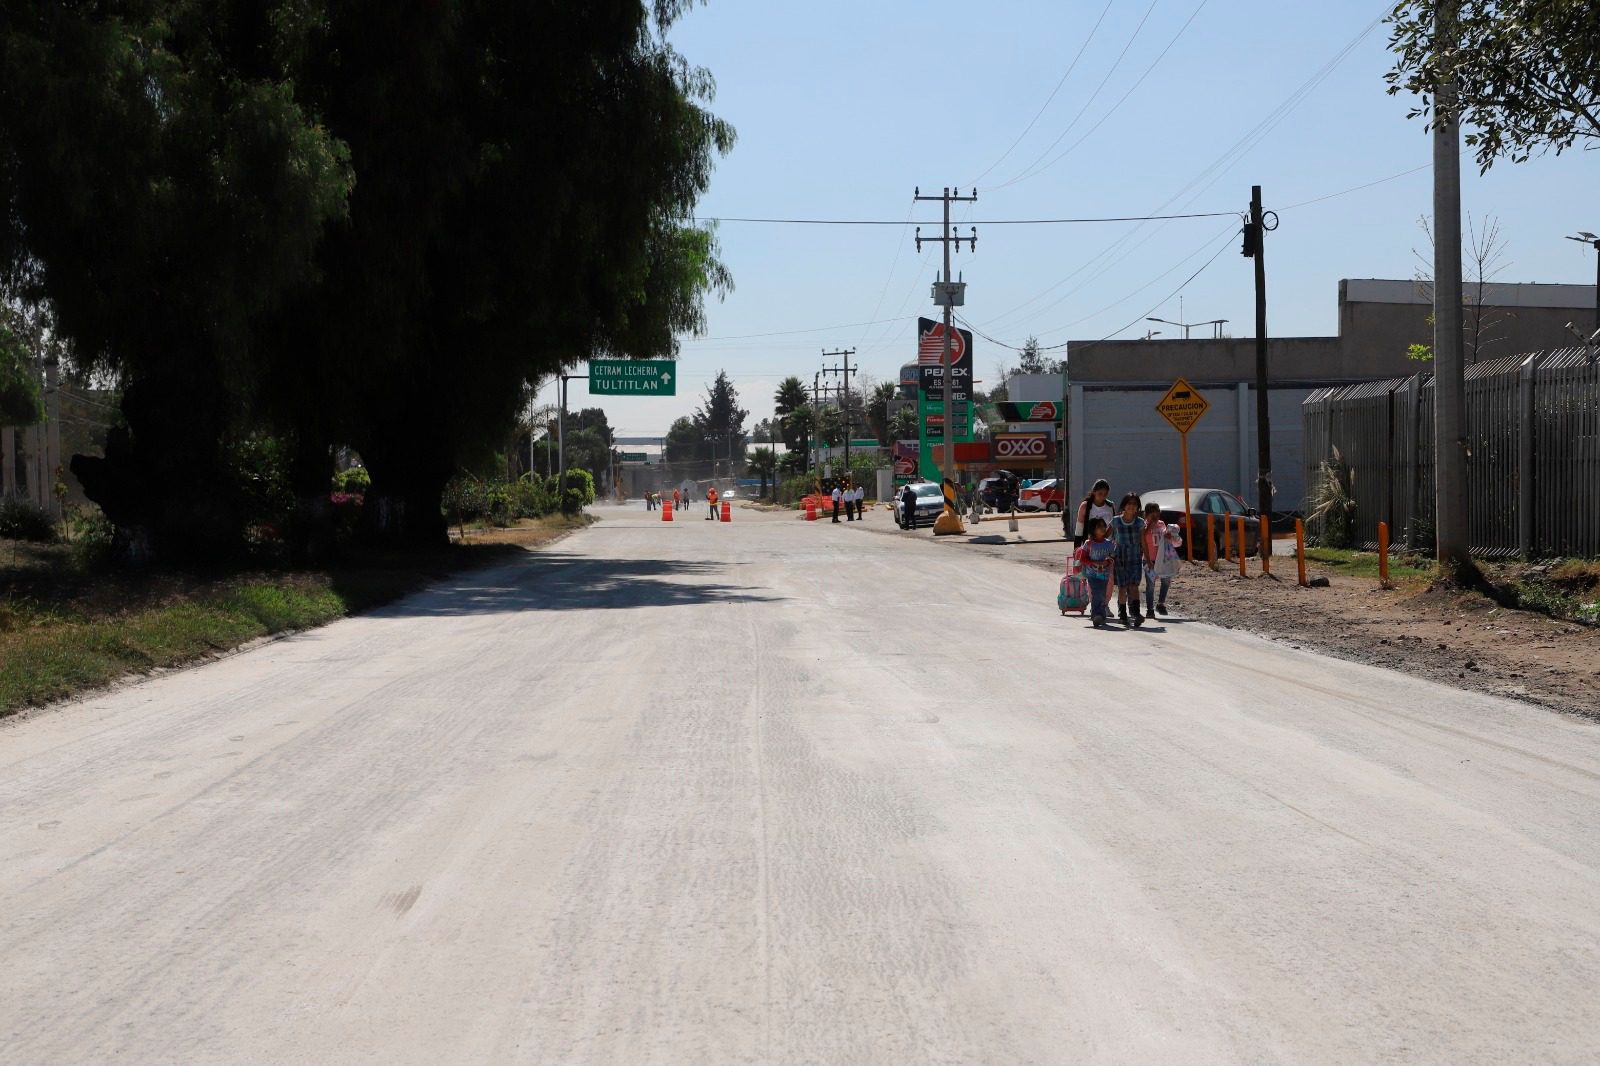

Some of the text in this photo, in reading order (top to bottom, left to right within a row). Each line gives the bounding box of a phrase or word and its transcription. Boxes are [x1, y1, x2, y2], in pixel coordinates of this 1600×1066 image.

[594, 366, 658, 376] CETRAM LECHERIA
[924, 368, 968, 377] PEEX
[595, 380, 658, 390] TULTITLAN
[1161, 402, 1204, 411] PRECAUCION
[997, 438, 1045, 457] OXXO
